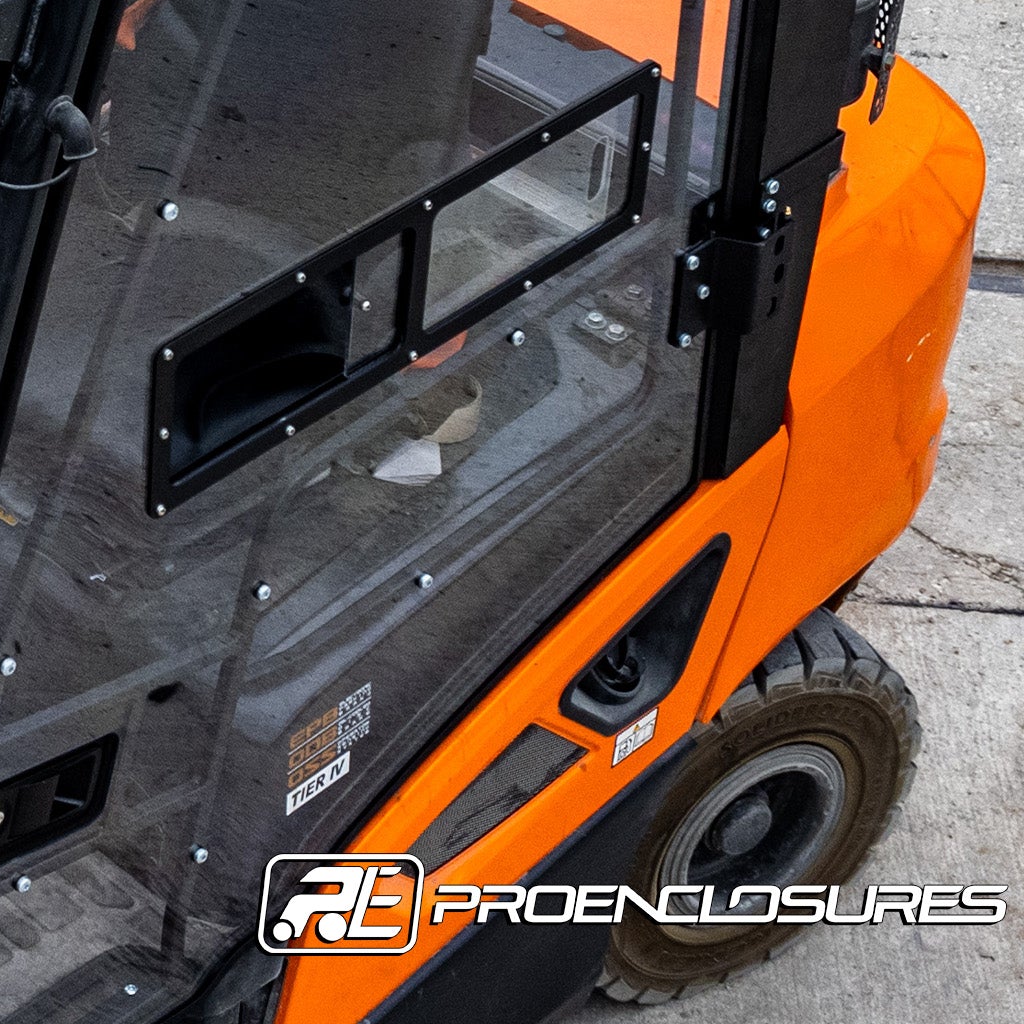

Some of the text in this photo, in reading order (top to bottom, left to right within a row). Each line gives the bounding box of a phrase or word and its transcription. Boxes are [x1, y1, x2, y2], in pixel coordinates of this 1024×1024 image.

[288, 726, 337, 769] ODB
[289, 706, 338, 750] EPB
[288, 744, 337, 789] OSS
[291, 759, 345, 808] TIER IV
